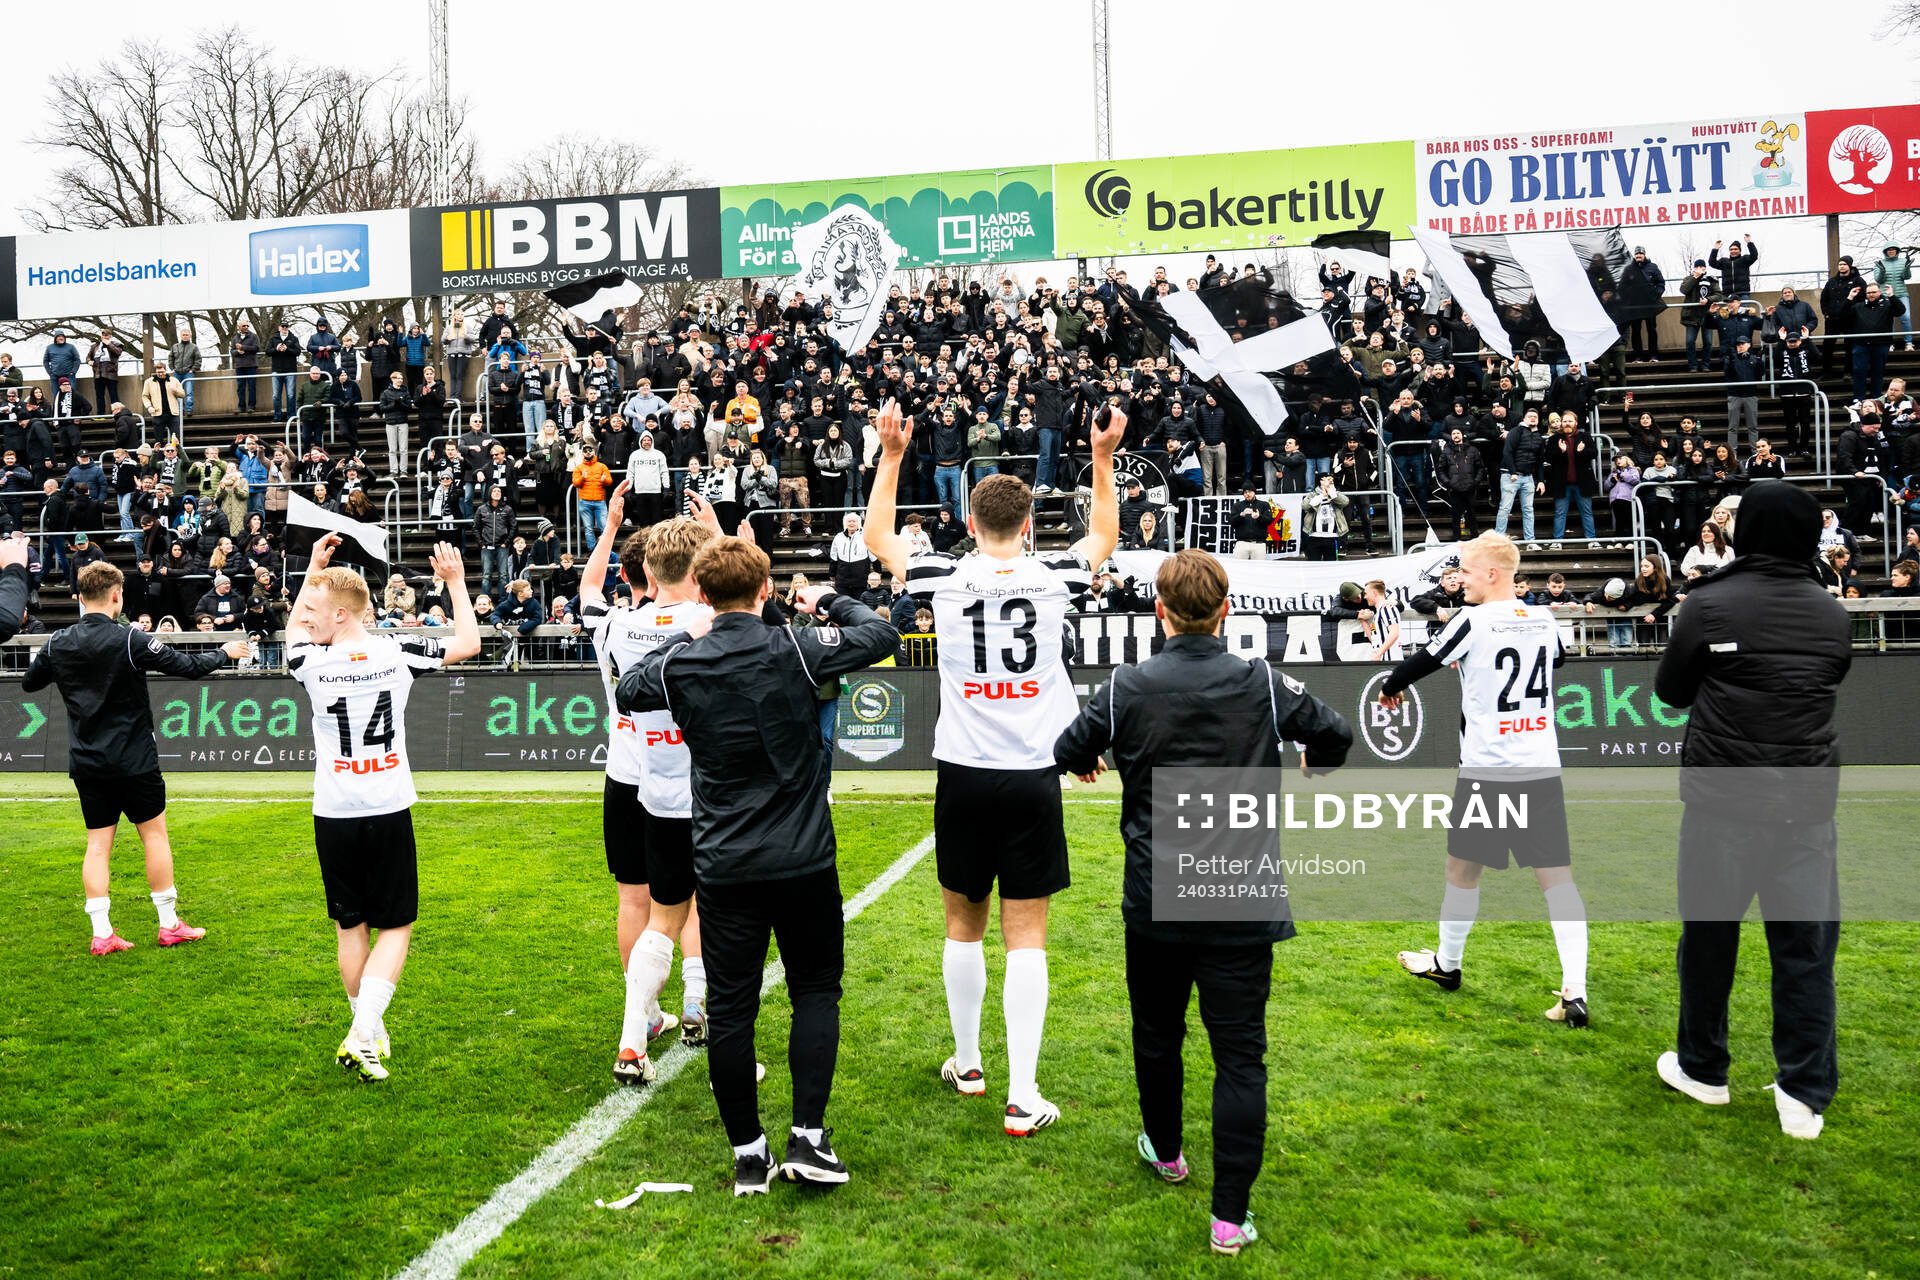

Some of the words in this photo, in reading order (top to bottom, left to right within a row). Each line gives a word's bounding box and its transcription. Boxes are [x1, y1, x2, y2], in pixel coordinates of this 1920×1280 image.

[1691, 121, 1757, 137] HUNDTVÄTT
[1427, 141, 1459, 154] BARA
[1464, 139, 1489, 152] HOS
[1494, 137, 1518, 150] OSS
[1531, 131, 1613, 149] SUPERFOAM!
[1429, 157, 1492, 207] GO
[1509, 137, 1730, 203] BILTVÄTT
[1147, 178, 1385, 231] bakertilly
[1429, 217, 1453, 234] NU
[1460, 211, 1507, 234] BÅDE
[1514, 208, 1537, 231] PÅ
[1544, 203, 1650, 229] PJÄSGATAN
[1657, 206, 1671, 223] &
[1678, 196, 1805, 221] PUMPGATAN!
[979, 211, 1030, 226] LANDS
[493, 196, 689, 269] BBM
[979, 223, 1035, 240] KRONA
[979, 238, 1014, 253] HEM
[259, 244, 361, 278] Haldex
[739, 247, 776, 267] För
[28, 259, 197, 287] Handelsbanken
[442, 271, 538, 289] BORSTAHUSENS
[541, 268, 580, 284] BYGG
[671, 262, 689, 276] AB
[965, 581, 1048, 598] Kundpartner
[962, 598, 1037, 674] 13
[319, 666, 397, 685] Kundpartner
[1495, 645, 1549, 713] 24
[964, 680, 1040, 700] PULS
[160, 686, 299, 738] akea
[485, 682, 609, 737] ake
[326, 690, 396, 758] 14
[847, 724, 896, 736] SUPERETTAN
[1499, 716, 1547, 735] PULS
[190, 750, 225, 762] PART
[232, 750, 251, 761] OF
[520, 749, 559, 761] PART
[566, 749, 586, 761] OF
[1600, 742, 1648, 755] PART
[1657, 741, 1683, 755] OF
[334, 753, 400, 775] PULS
